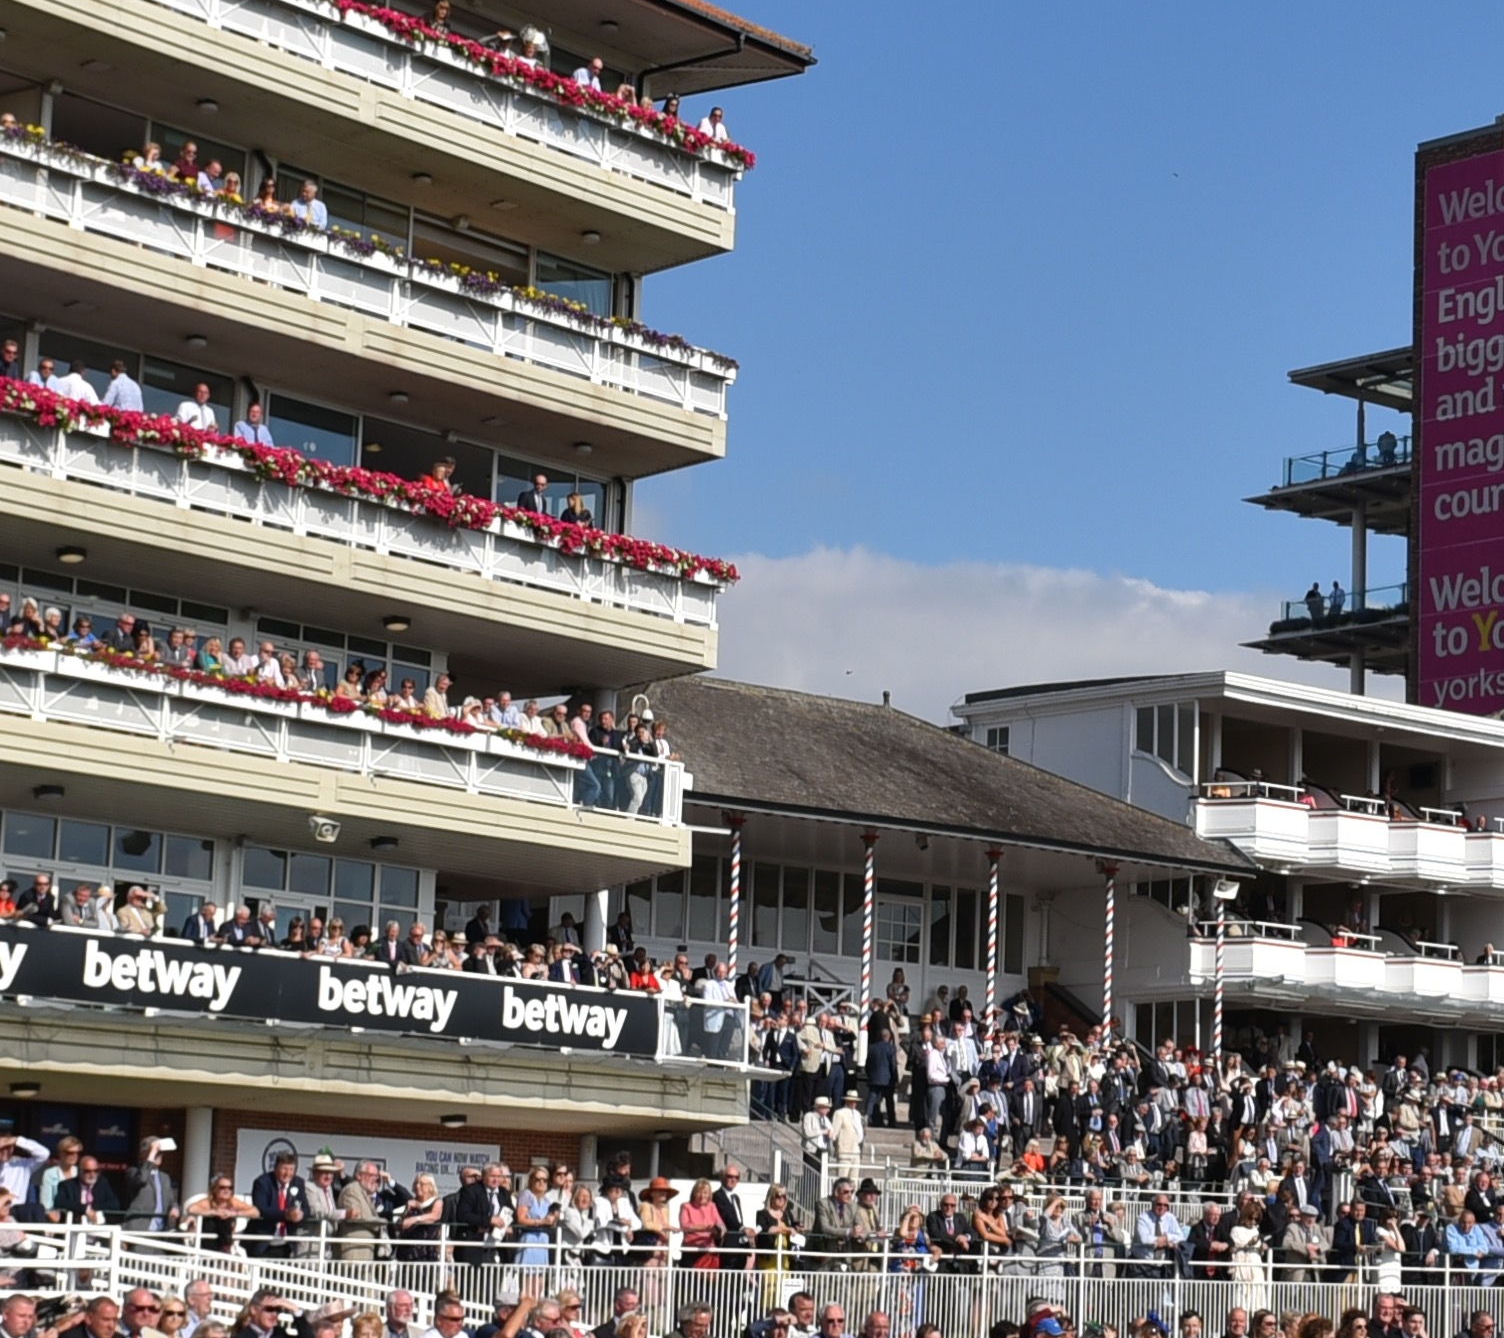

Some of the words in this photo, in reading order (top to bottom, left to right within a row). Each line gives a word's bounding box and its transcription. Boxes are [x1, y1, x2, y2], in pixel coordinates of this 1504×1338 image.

[1436, 239, 1471, 275] to
[1436, 377, 1496, 422] and
[1433, 621, 1468, 658] to
[82, 939, 242, 1011] betway
[318, 964, 458, 1033] betway
[502, 986, 628, 1049] betway
